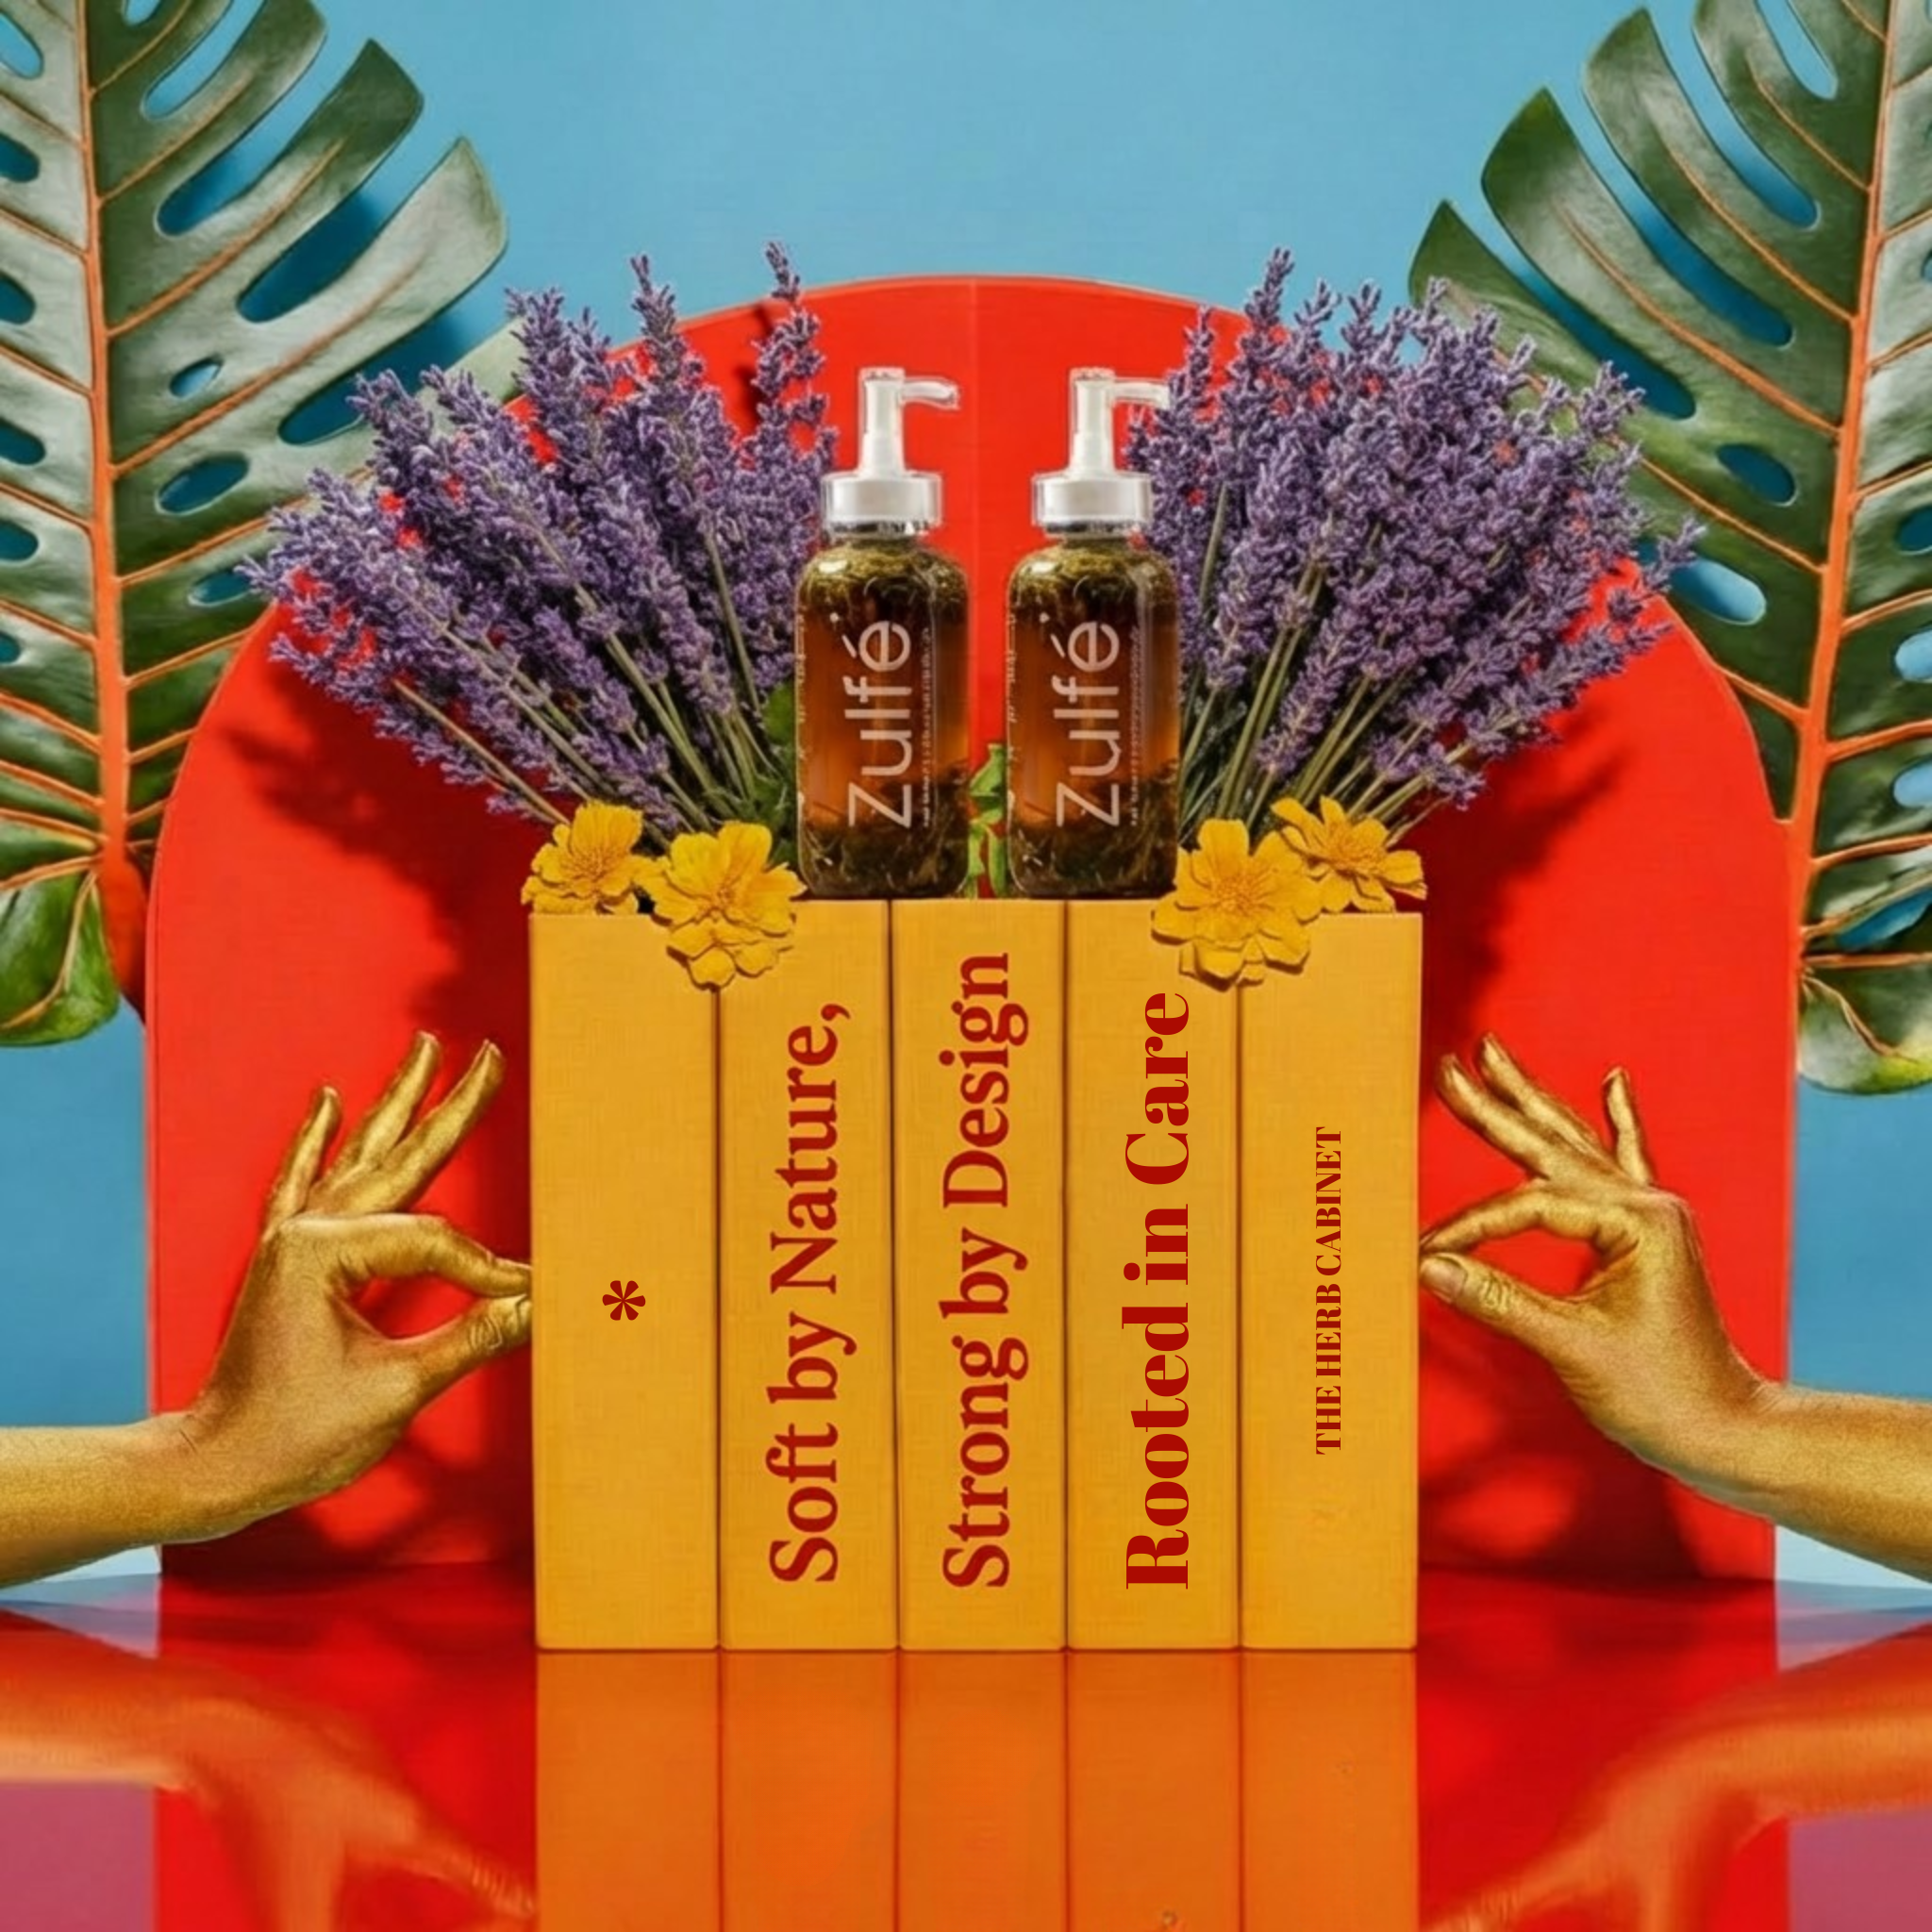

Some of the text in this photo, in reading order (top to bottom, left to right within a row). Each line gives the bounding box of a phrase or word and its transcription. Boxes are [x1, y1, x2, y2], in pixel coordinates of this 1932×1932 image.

[841, 620, 912, 829] Zulfé
[1050, 621, 1121, 828] Zulfé
[765, 1004, 858, 1583] Soft by Nature,
[939, 953, 1029, 1589] Strong by Design
[1121, 992, 1190, 1590] Rooted in Care
[1315, 1126, 1341, 1456] THE HERB CABINET
